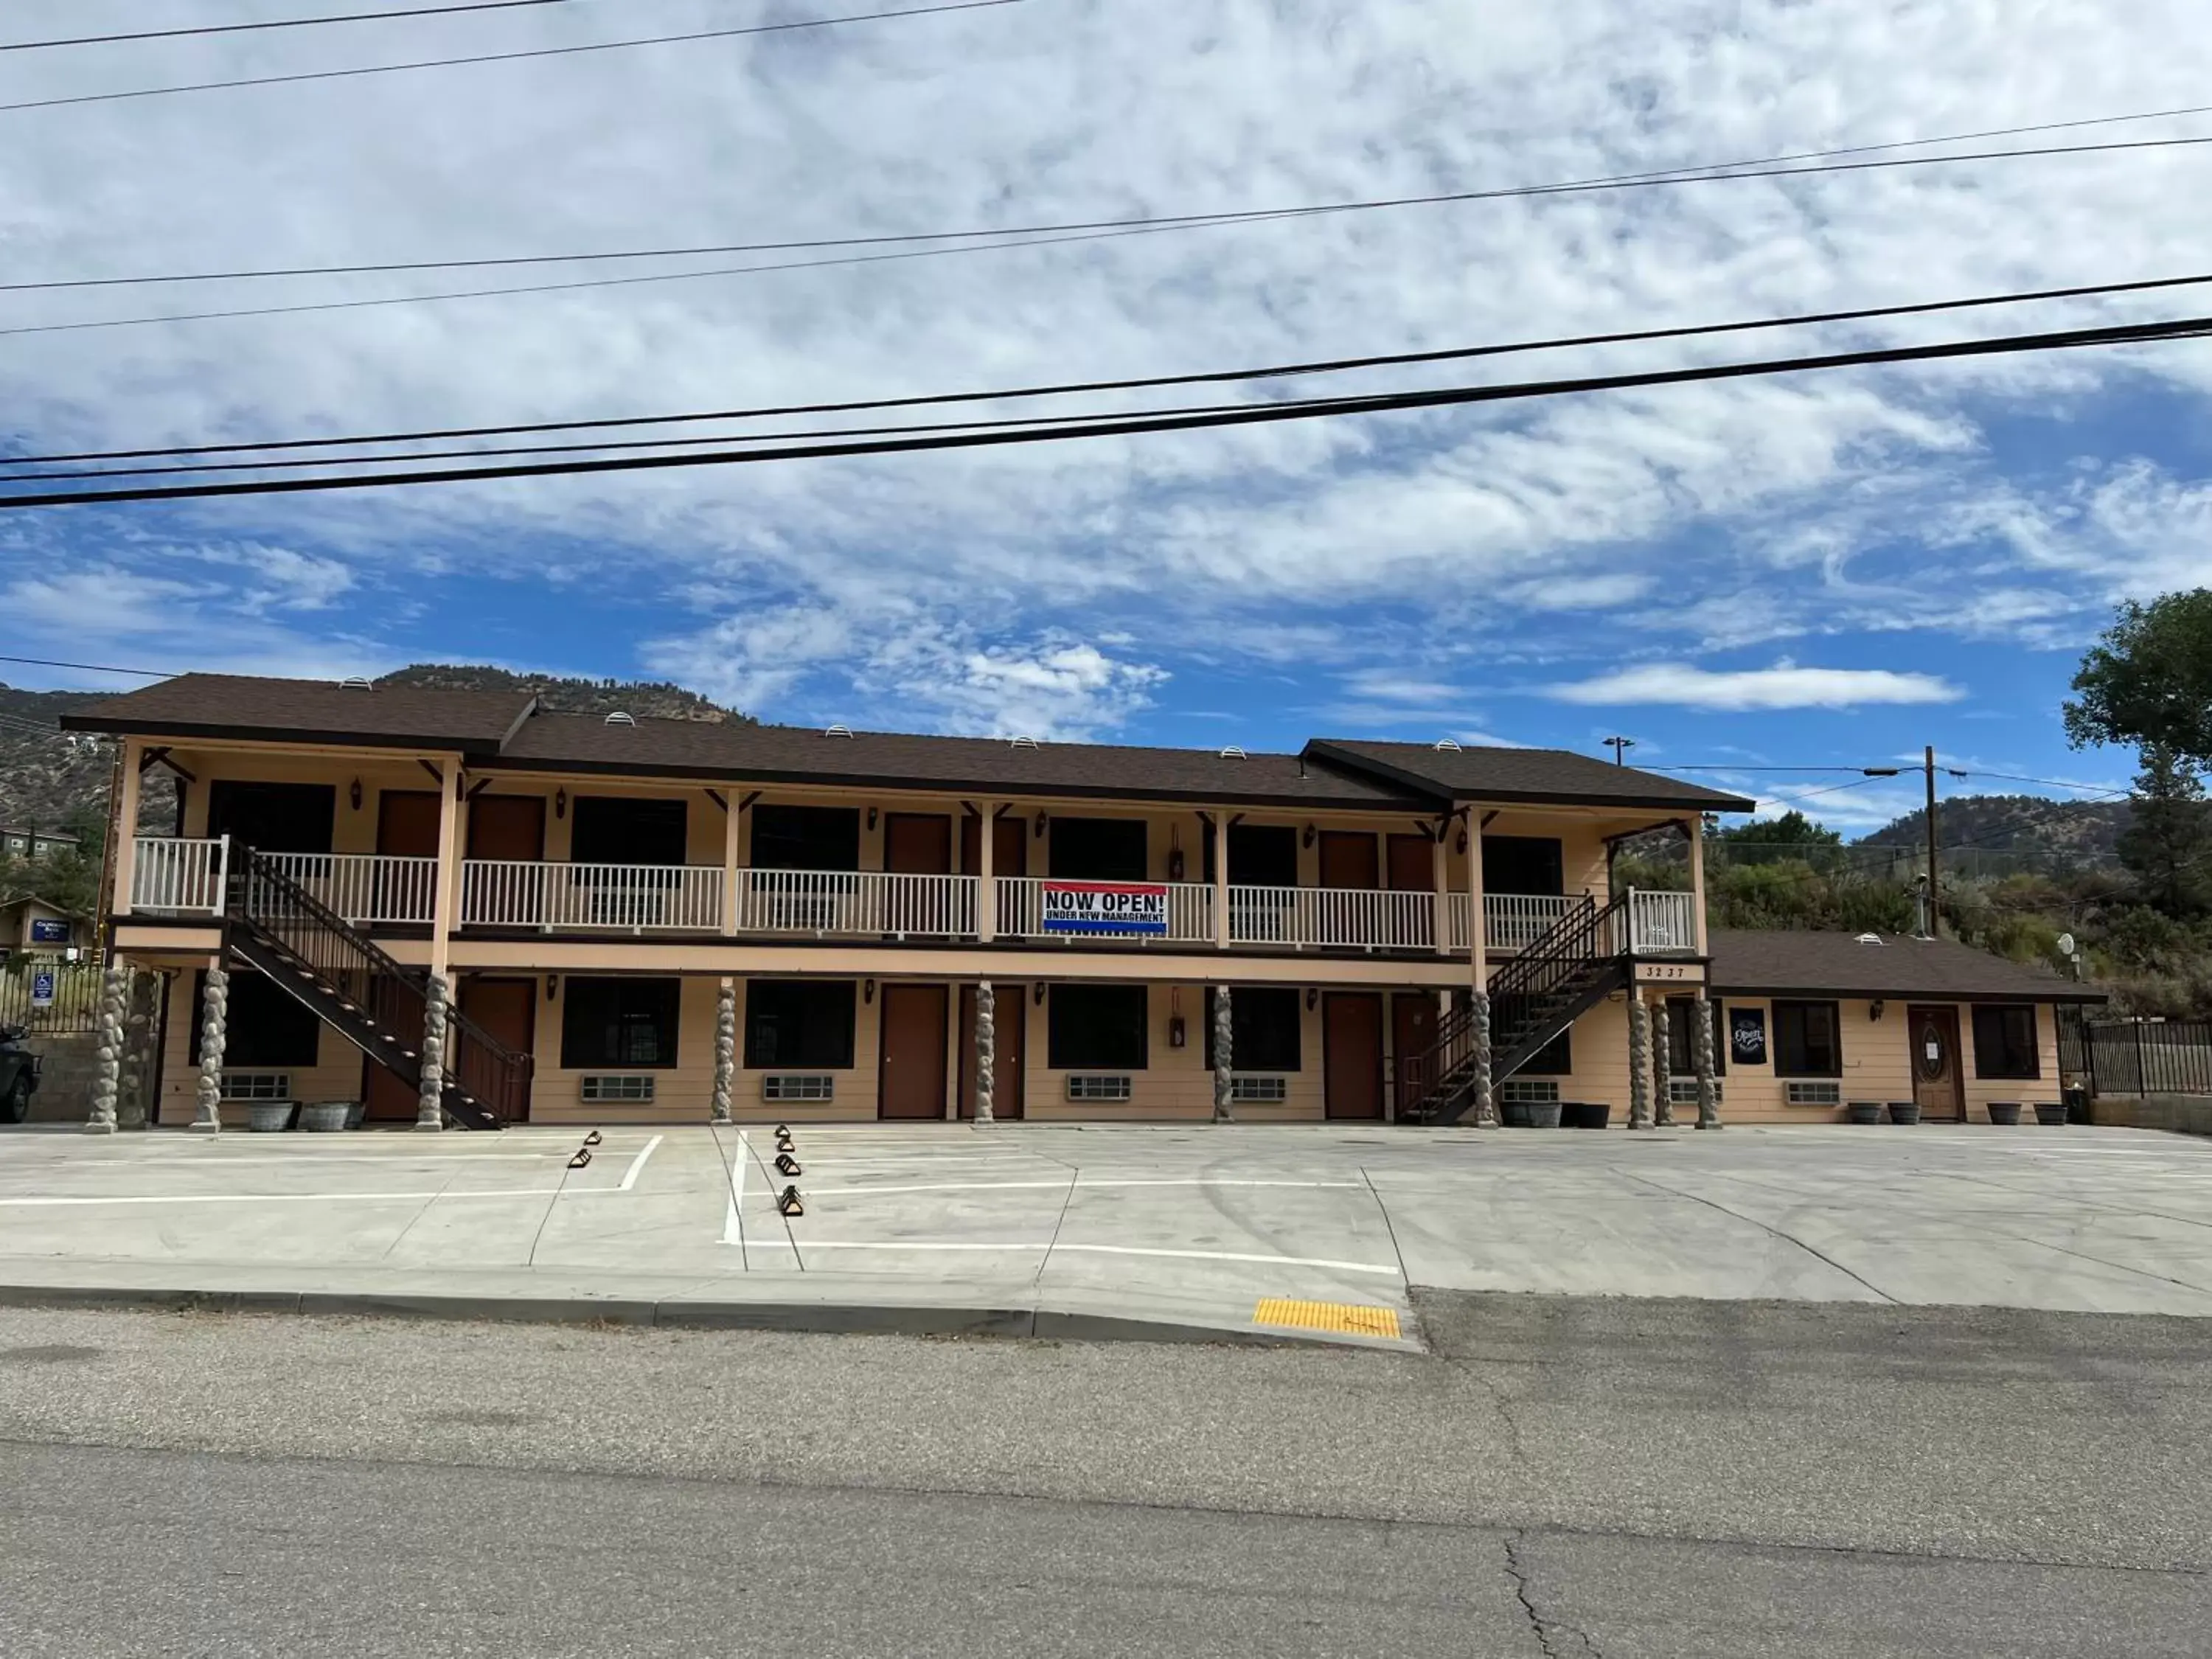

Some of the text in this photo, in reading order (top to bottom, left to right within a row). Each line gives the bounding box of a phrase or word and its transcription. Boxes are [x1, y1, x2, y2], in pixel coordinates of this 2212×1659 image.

[1046, 891, 1164, 912] NOW OPEN!
[1046, 911, 1164, 922] UNDER NEW MANAGEMENT
[1646, 967, 1684, 977] 3237
